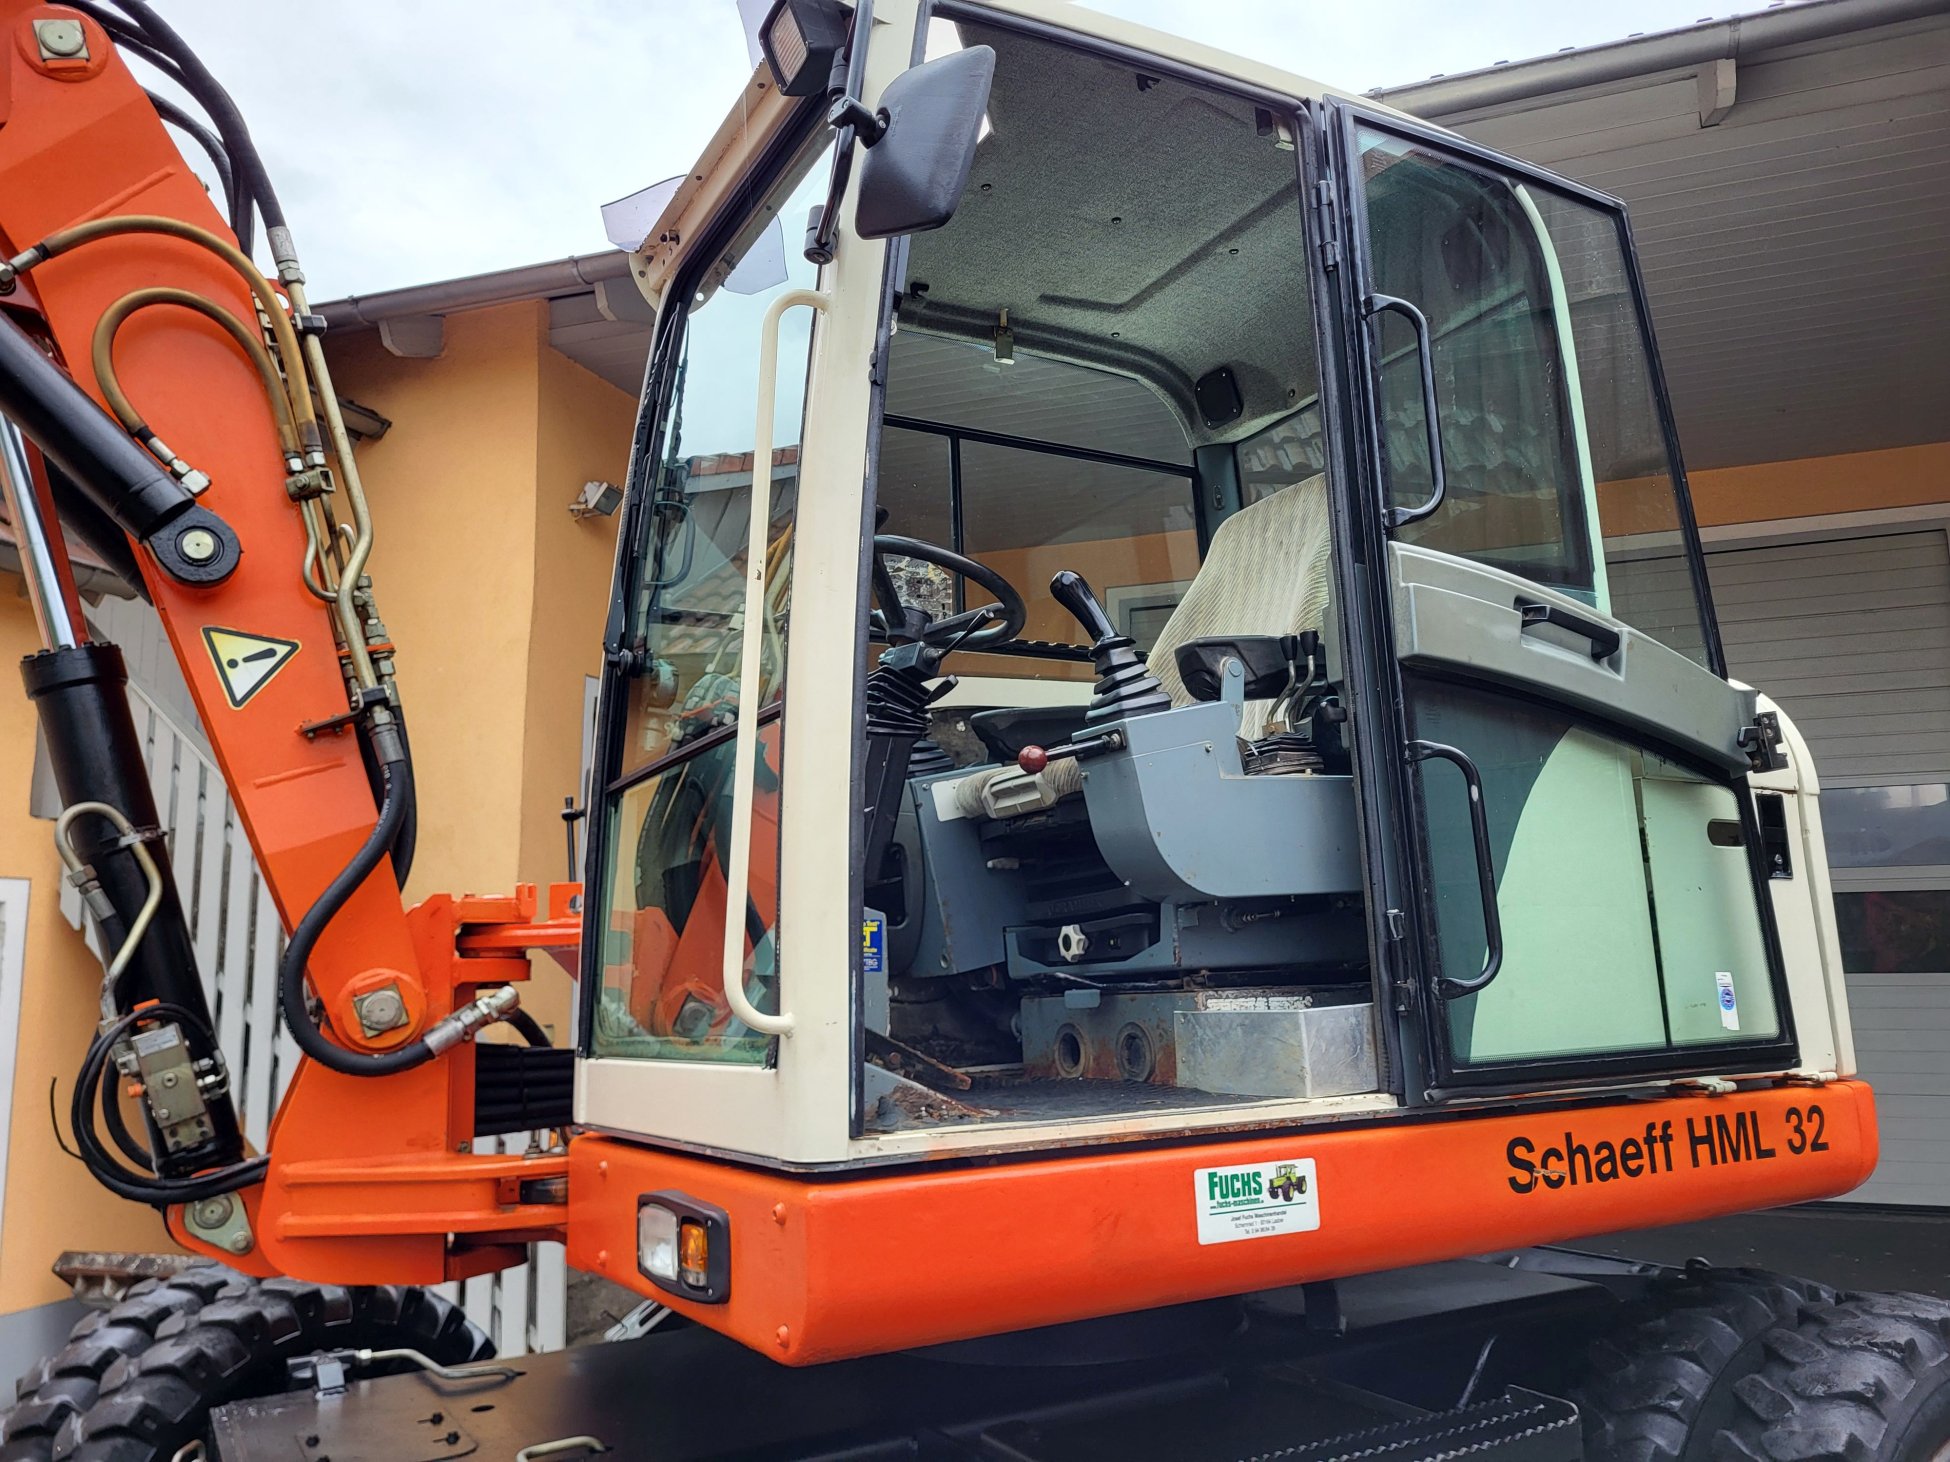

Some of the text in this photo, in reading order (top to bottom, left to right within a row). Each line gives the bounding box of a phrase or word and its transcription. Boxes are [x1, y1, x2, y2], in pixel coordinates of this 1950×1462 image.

[1507, 1105, 1829, 1194] Schaeff HML 32
[1208, 1171, 1262, 1200] FUCHS
